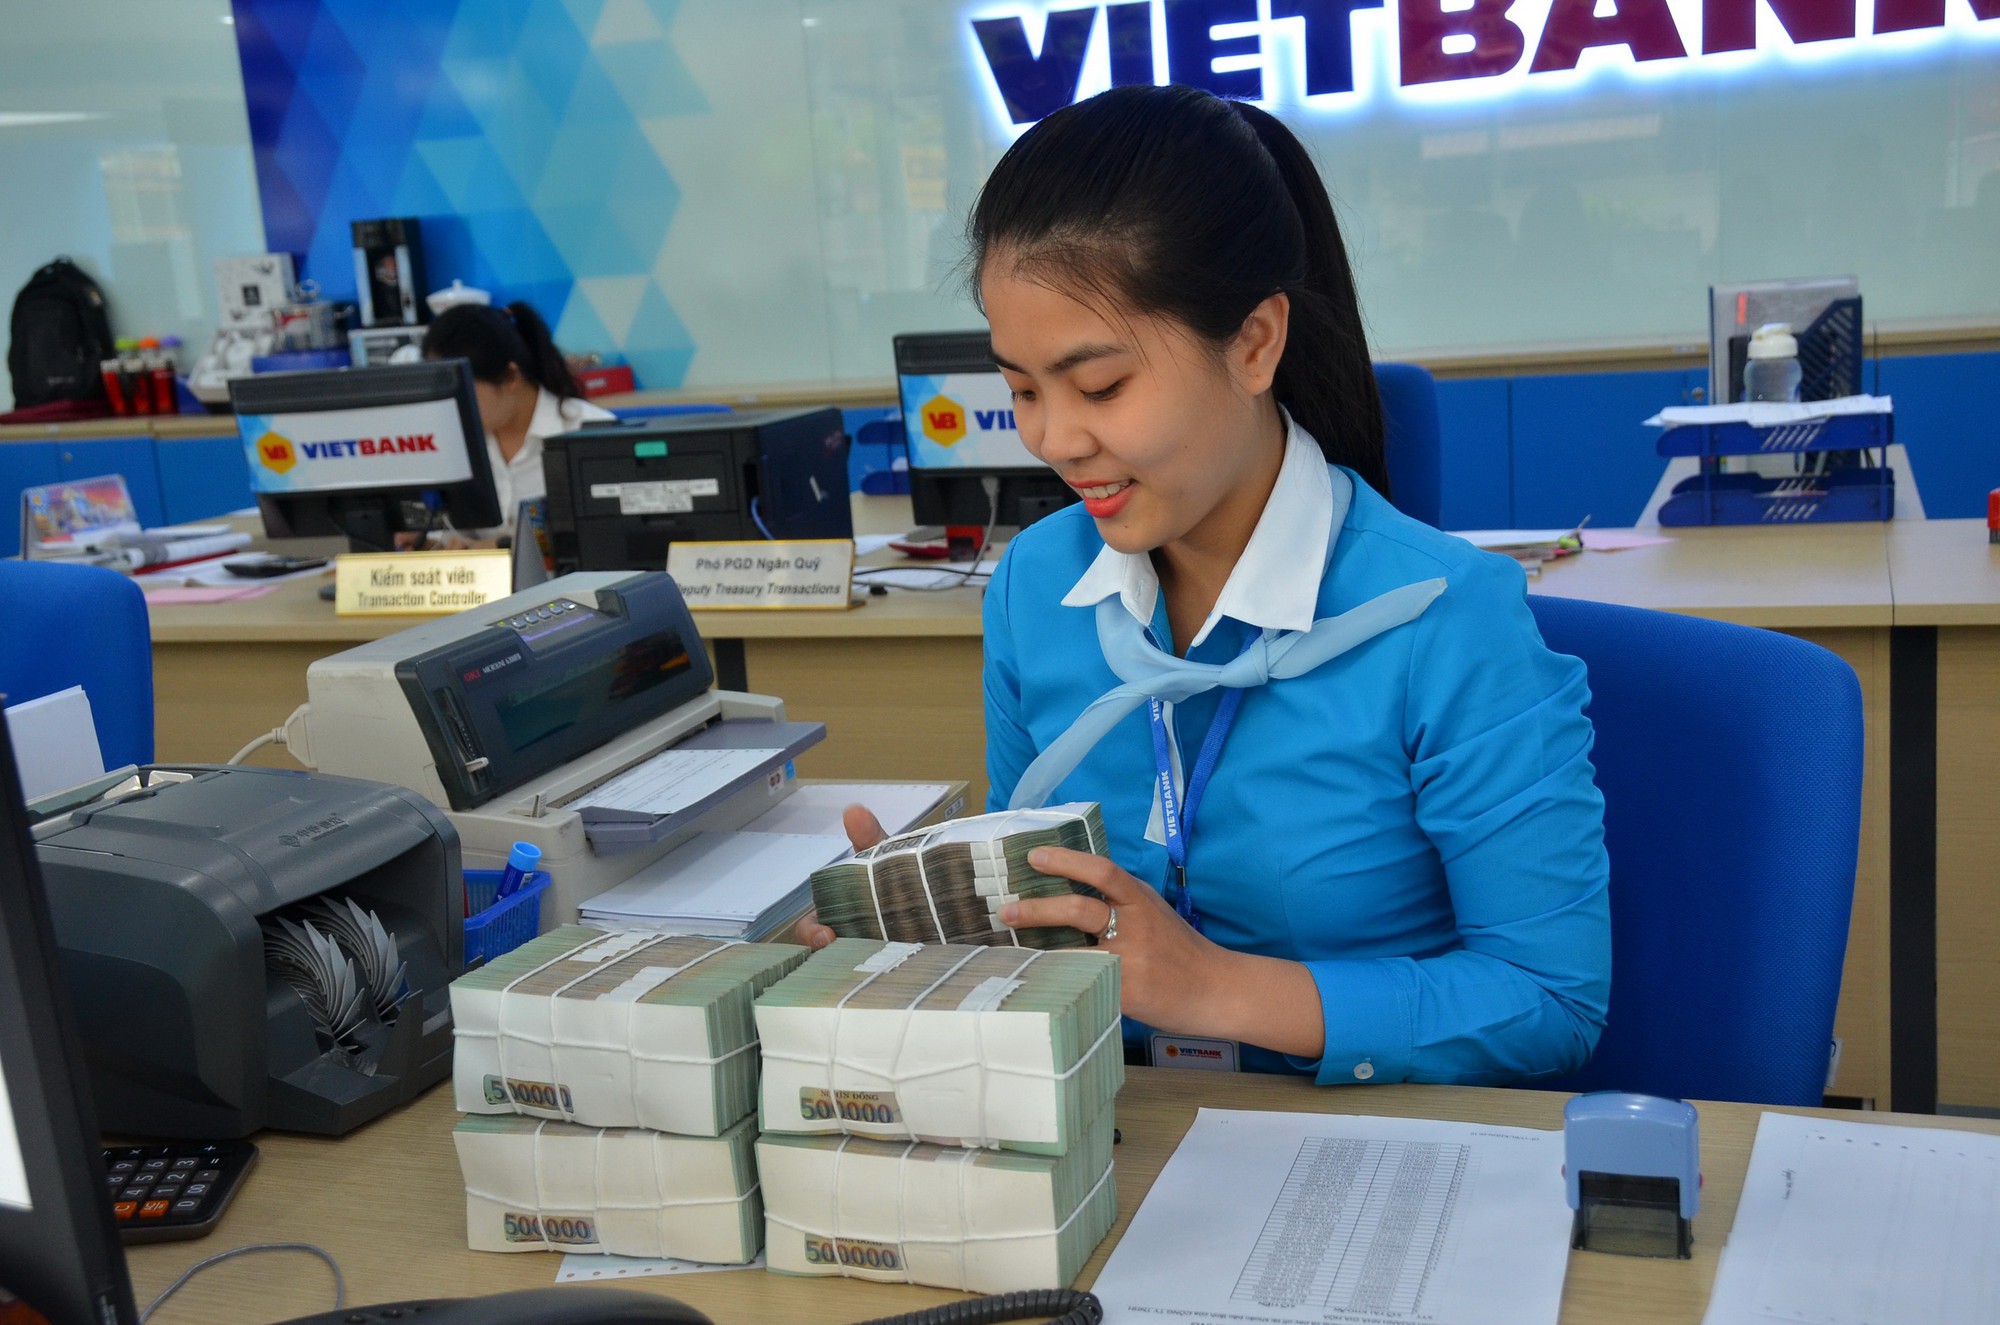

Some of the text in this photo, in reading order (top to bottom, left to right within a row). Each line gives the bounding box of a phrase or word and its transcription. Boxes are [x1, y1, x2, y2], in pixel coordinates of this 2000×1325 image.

[928, 411, 958, 430] VB
[302, 434, 438, 460] VIETBANK
[724, 557, 753, 570] PGD
[756, 556, 790, 572] Ngân
[370, 564, 476, 587] Kiểm soát viên
[715, 583, 764, 597] Treasury
[767, 582, 841, 595] Transactions
[357, 592, 425, 607] Transaction
[1161, 770, 1178, 838] VIETBANK
